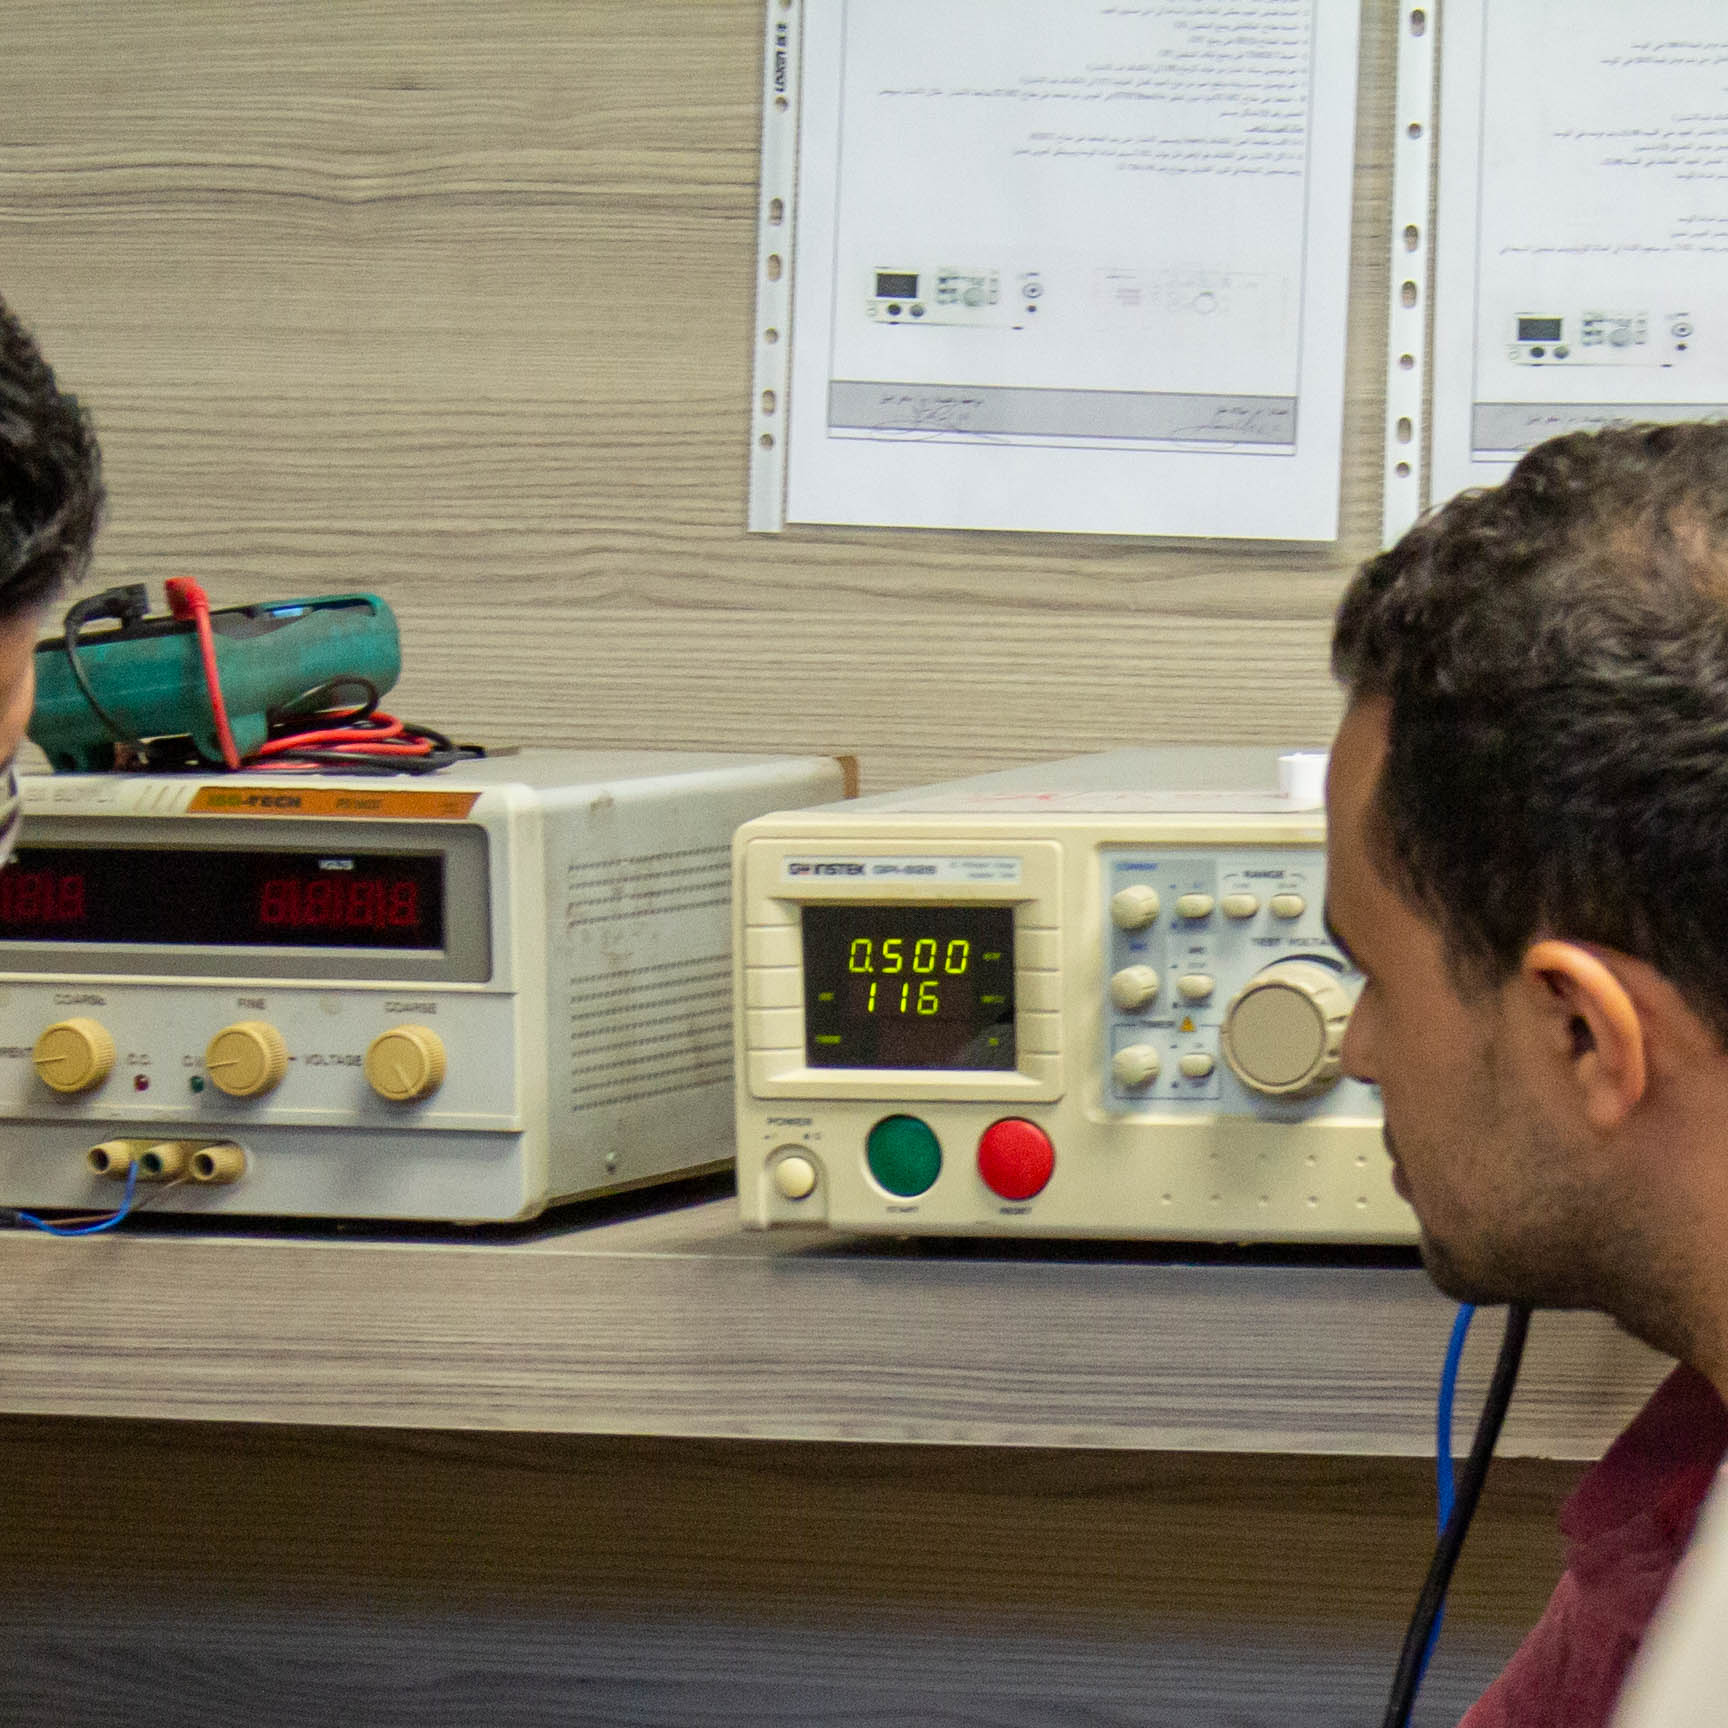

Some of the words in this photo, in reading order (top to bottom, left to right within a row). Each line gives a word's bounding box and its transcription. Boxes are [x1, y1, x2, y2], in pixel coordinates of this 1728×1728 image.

[848, 937, 970, 975] 0.500
[237, 997, 266, 1010] FINE
[867, 980, 940, 1015] 116
[304, 1054, 363, 1067] VOLTAGE
